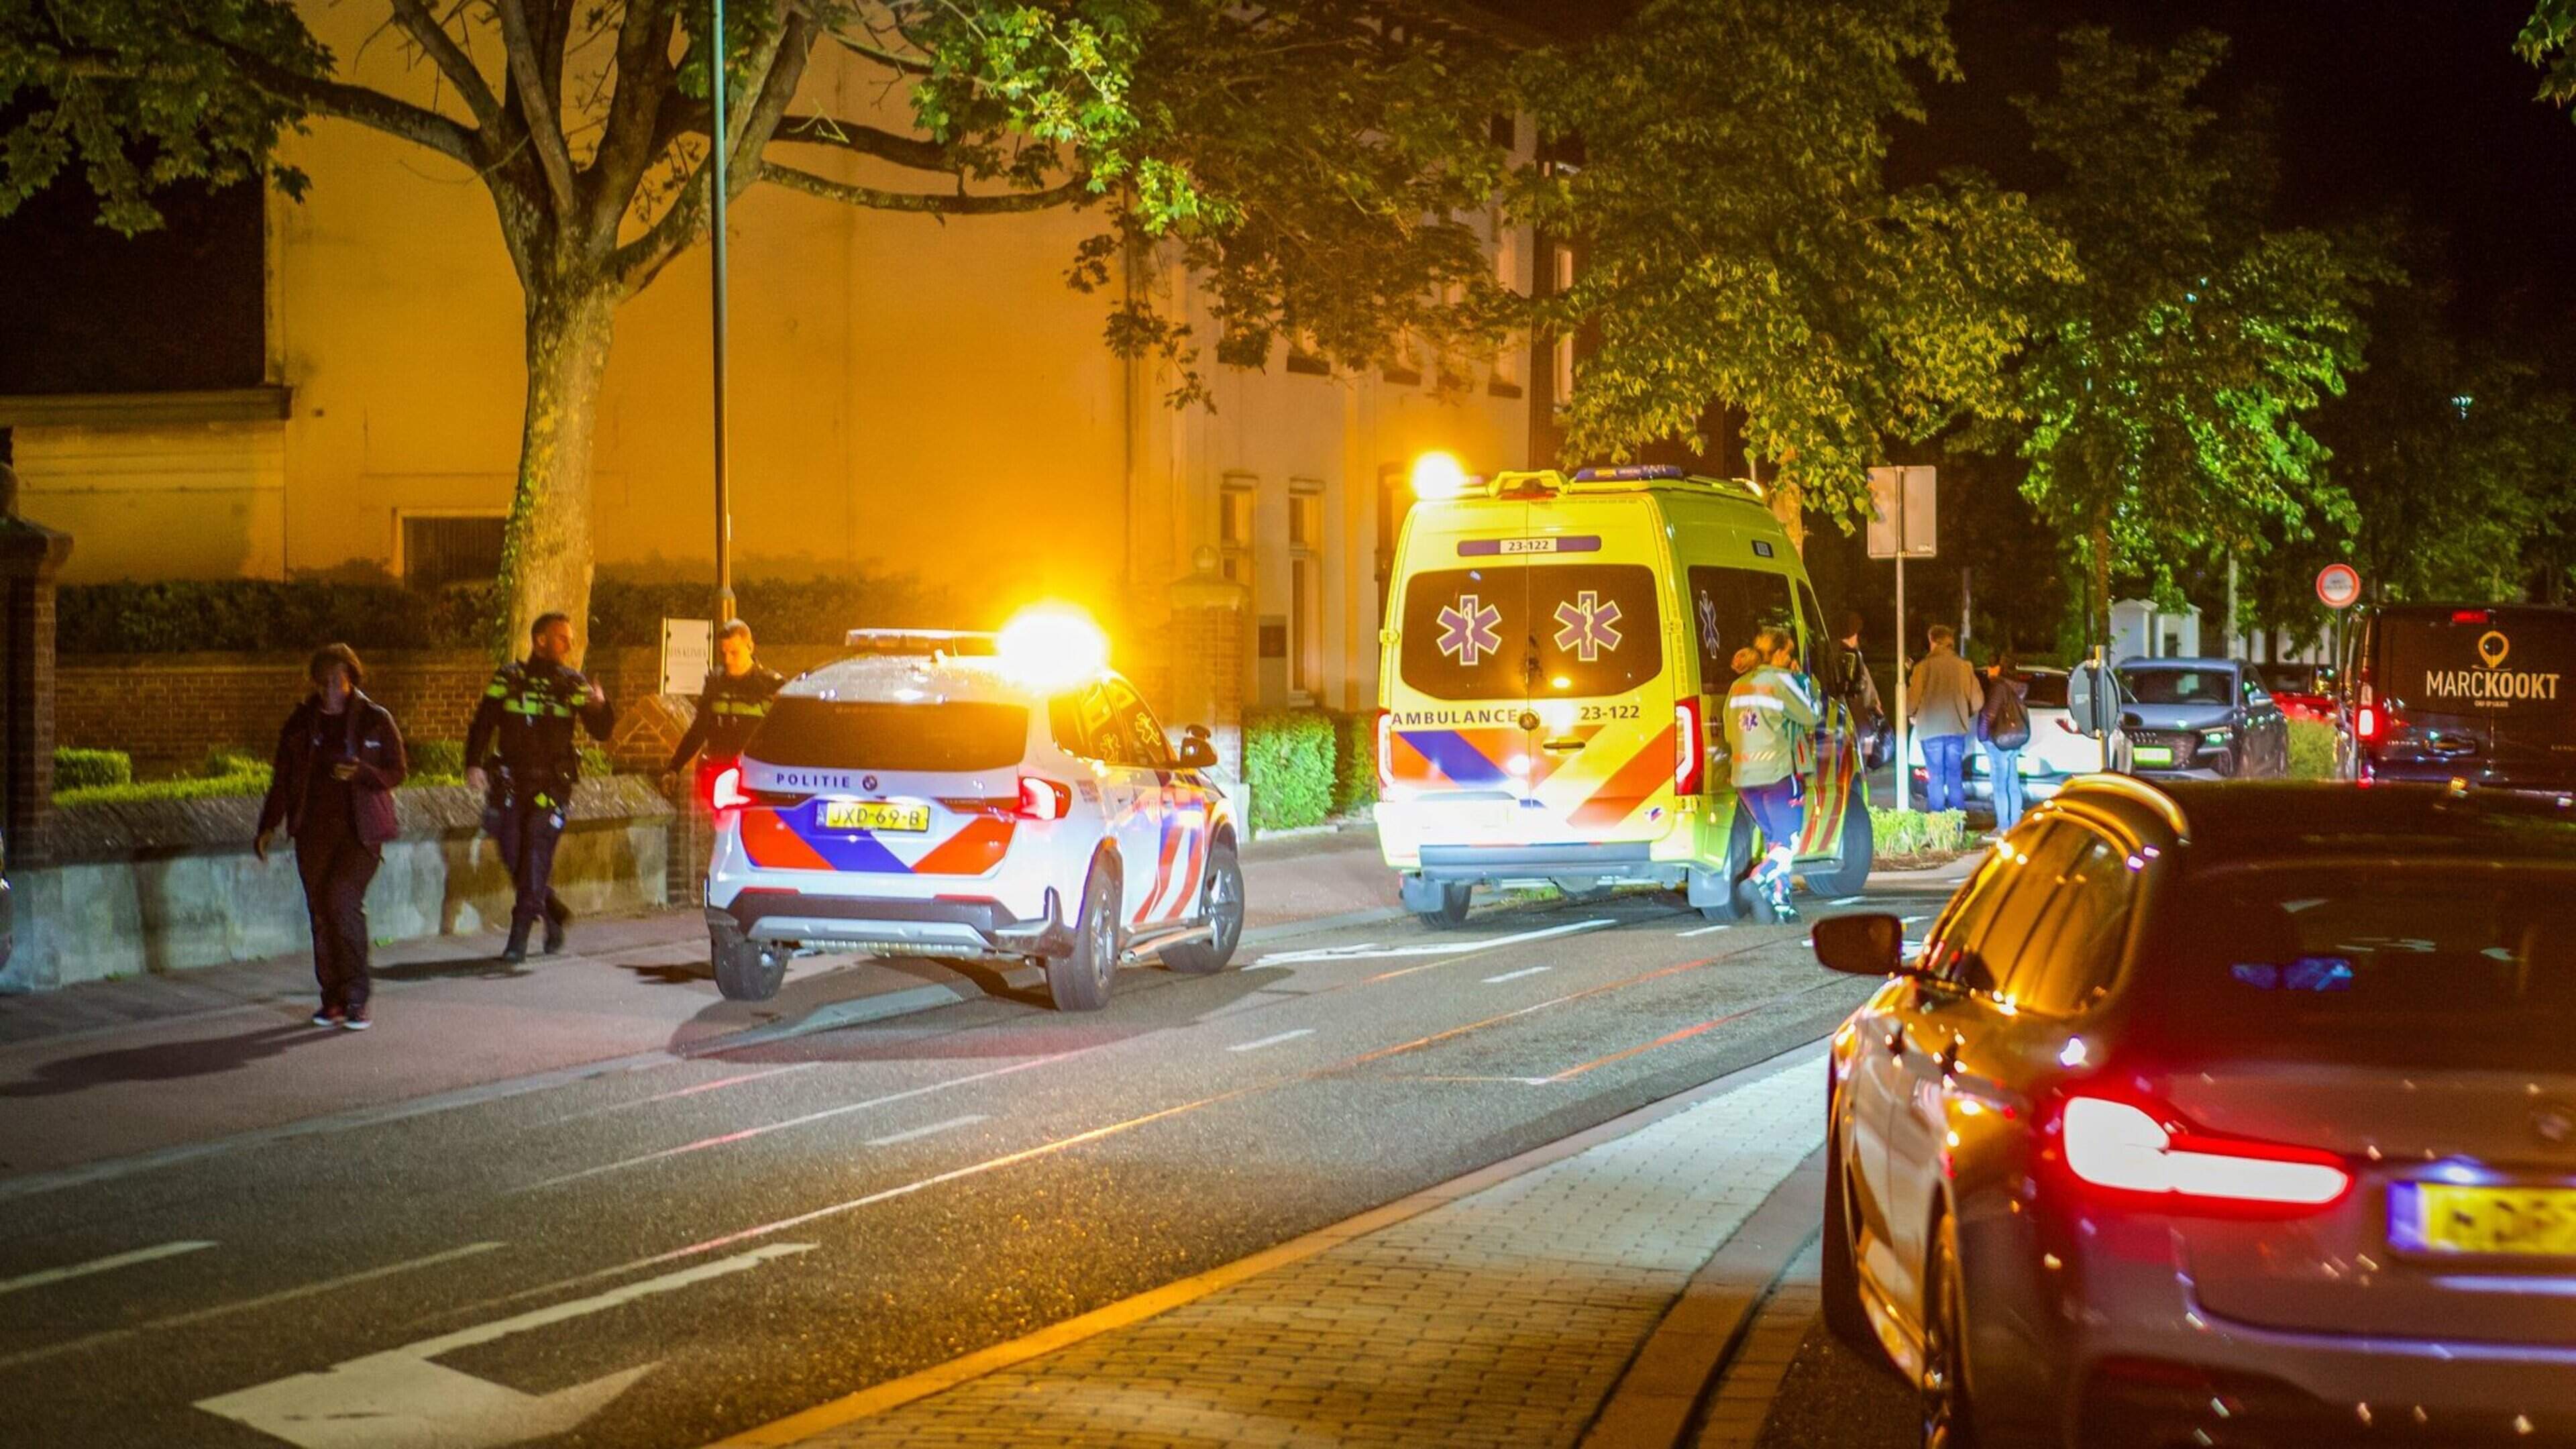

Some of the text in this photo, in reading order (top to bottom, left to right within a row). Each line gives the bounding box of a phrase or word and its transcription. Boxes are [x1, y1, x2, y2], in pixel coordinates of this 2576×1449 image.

[1509, 541, 1549, 551] 23-122
[2426, 669, 2561, 699] MARCKOOKT
[1391, 708, 1517, 725] AMBULANCE
[1580, 706, 1640, 720] 23-122
[776, 773, 851, 788] POLITIE
[832, 807, 920, 828] JXD-69-B
